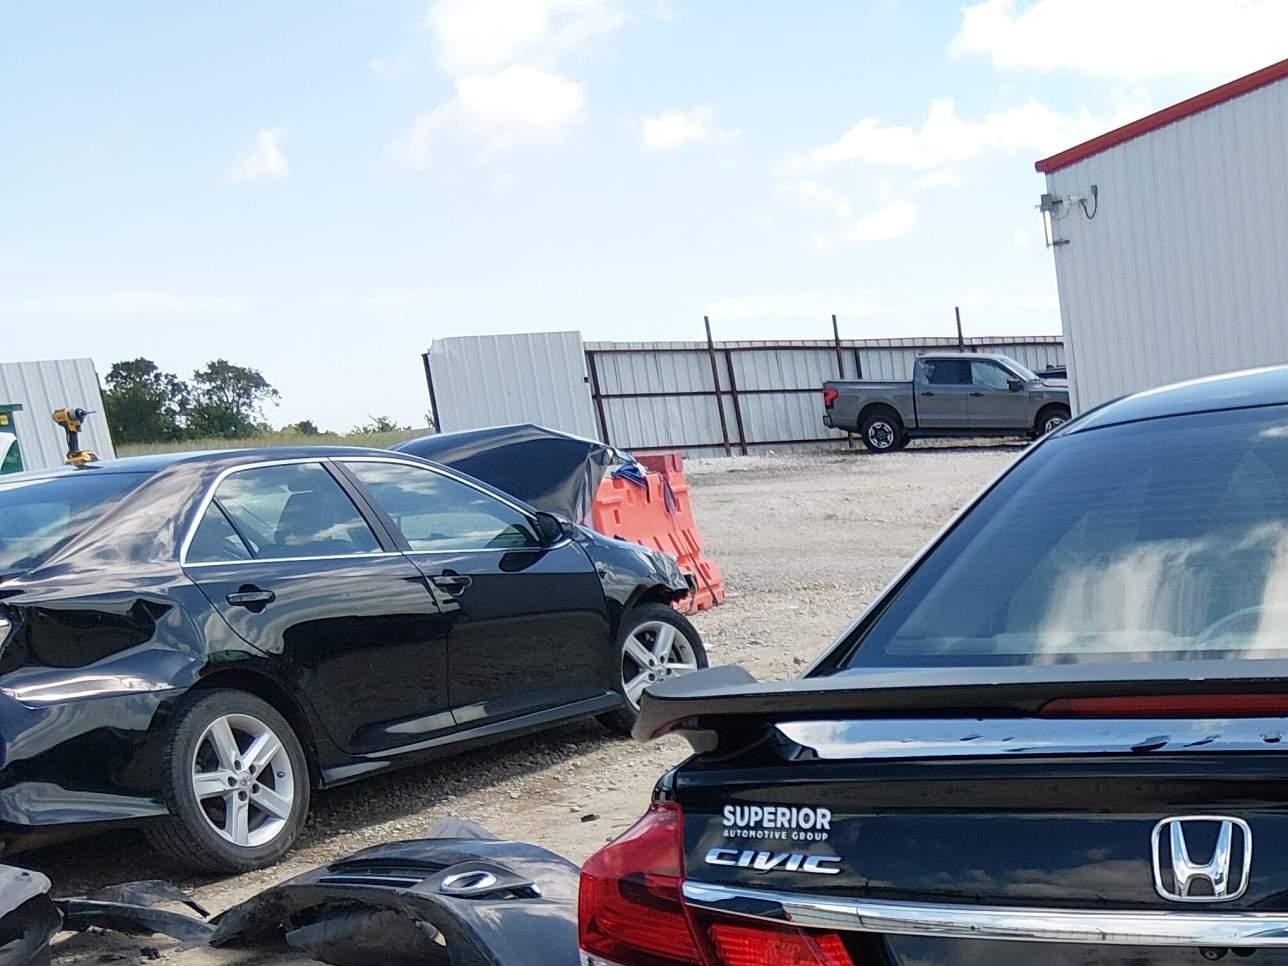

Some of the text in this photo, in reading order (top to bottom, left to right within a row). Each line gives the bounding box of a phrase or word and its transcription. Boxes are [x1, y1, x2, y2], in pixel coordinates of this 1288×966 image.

[723, 805, 832, 830] SUPERIOR
[723, 829, 829, 841] AUTOMOTIVE GROUP
[705, 848, 842, 875] CIVIC
